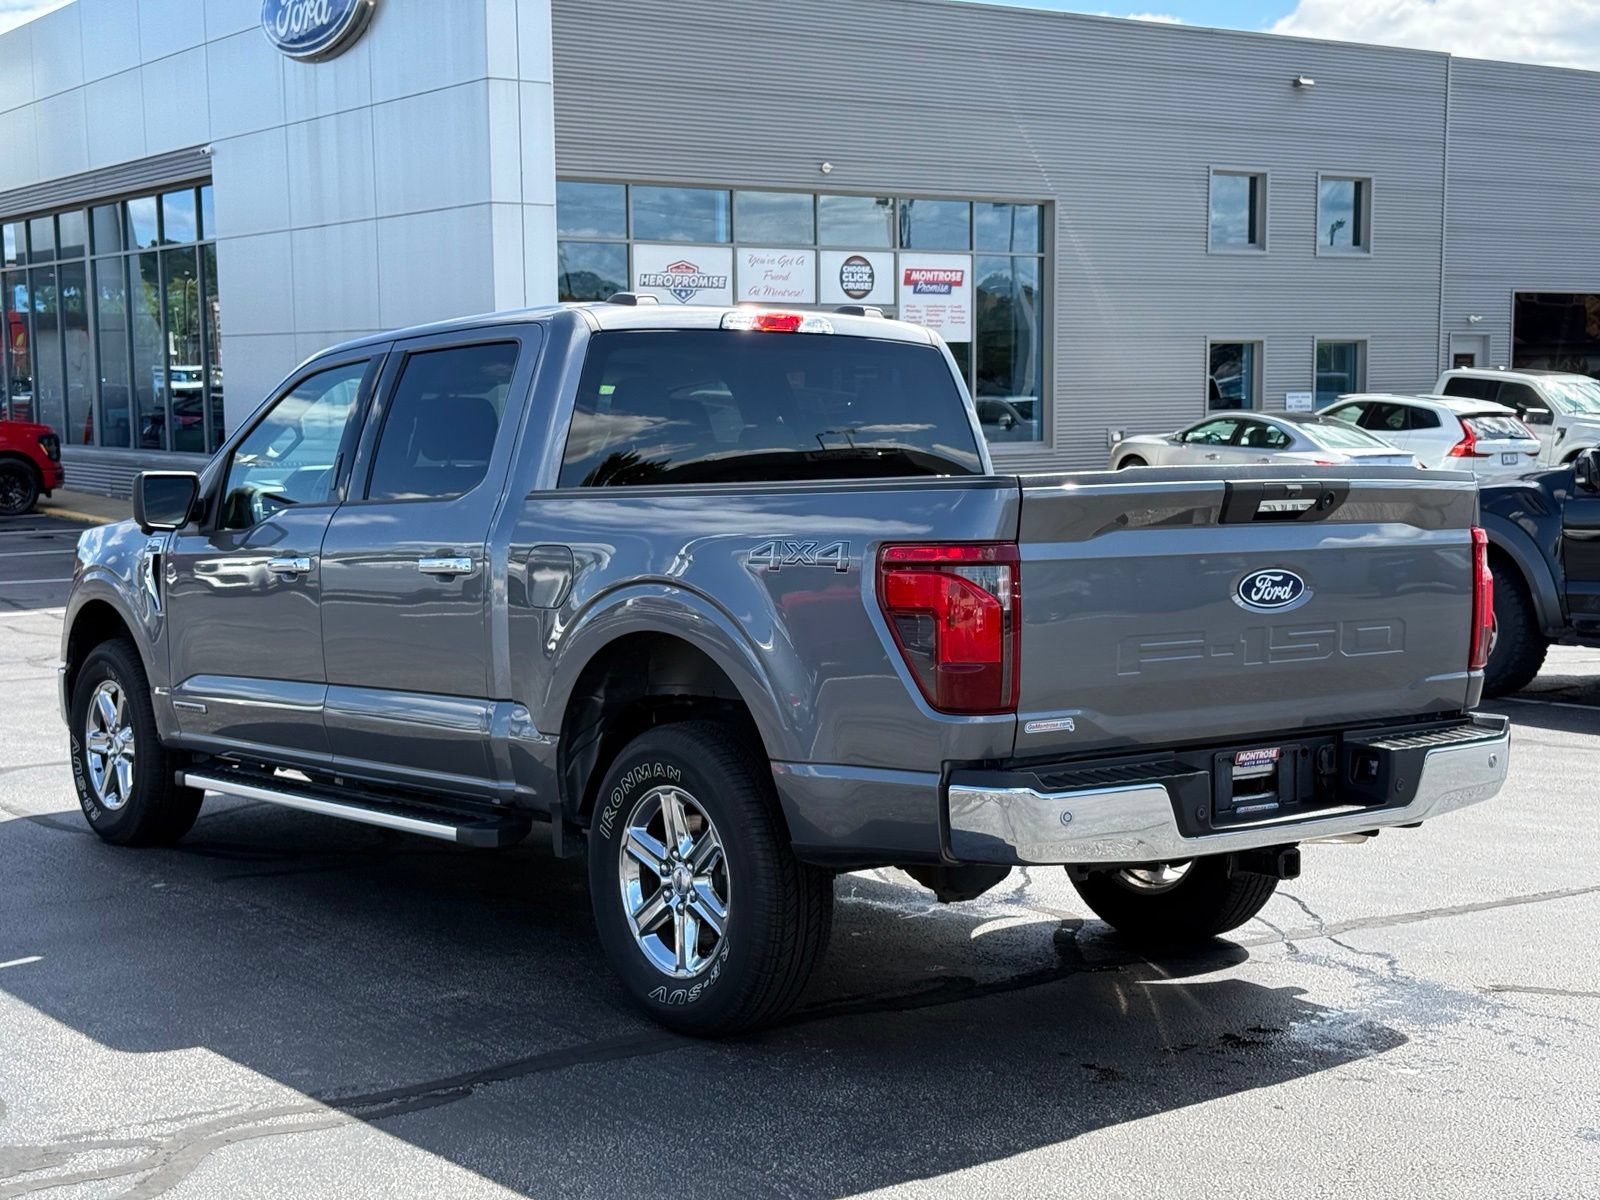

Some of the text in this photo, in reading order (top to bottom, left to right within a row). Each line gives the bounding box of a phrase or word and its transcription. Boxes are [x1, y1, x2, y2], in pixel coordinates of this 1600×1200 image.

[276, 0, 332, 37] Ford
[796, 255, 805, 266] A
[640, 274, 727, 289] HERO PROMISE
[763, 270, 791, 281] Friend
[910, 270, 962, 282] MONTROSE
[915, 281, 950, 293] Promise
[1251, 574, 1294, 601] Ford
[1117, 617, 1408, 676] F-150
[1238, 749, 1278, 762] MONTROSE
[600, 763, 681, 839] IRONMAN
